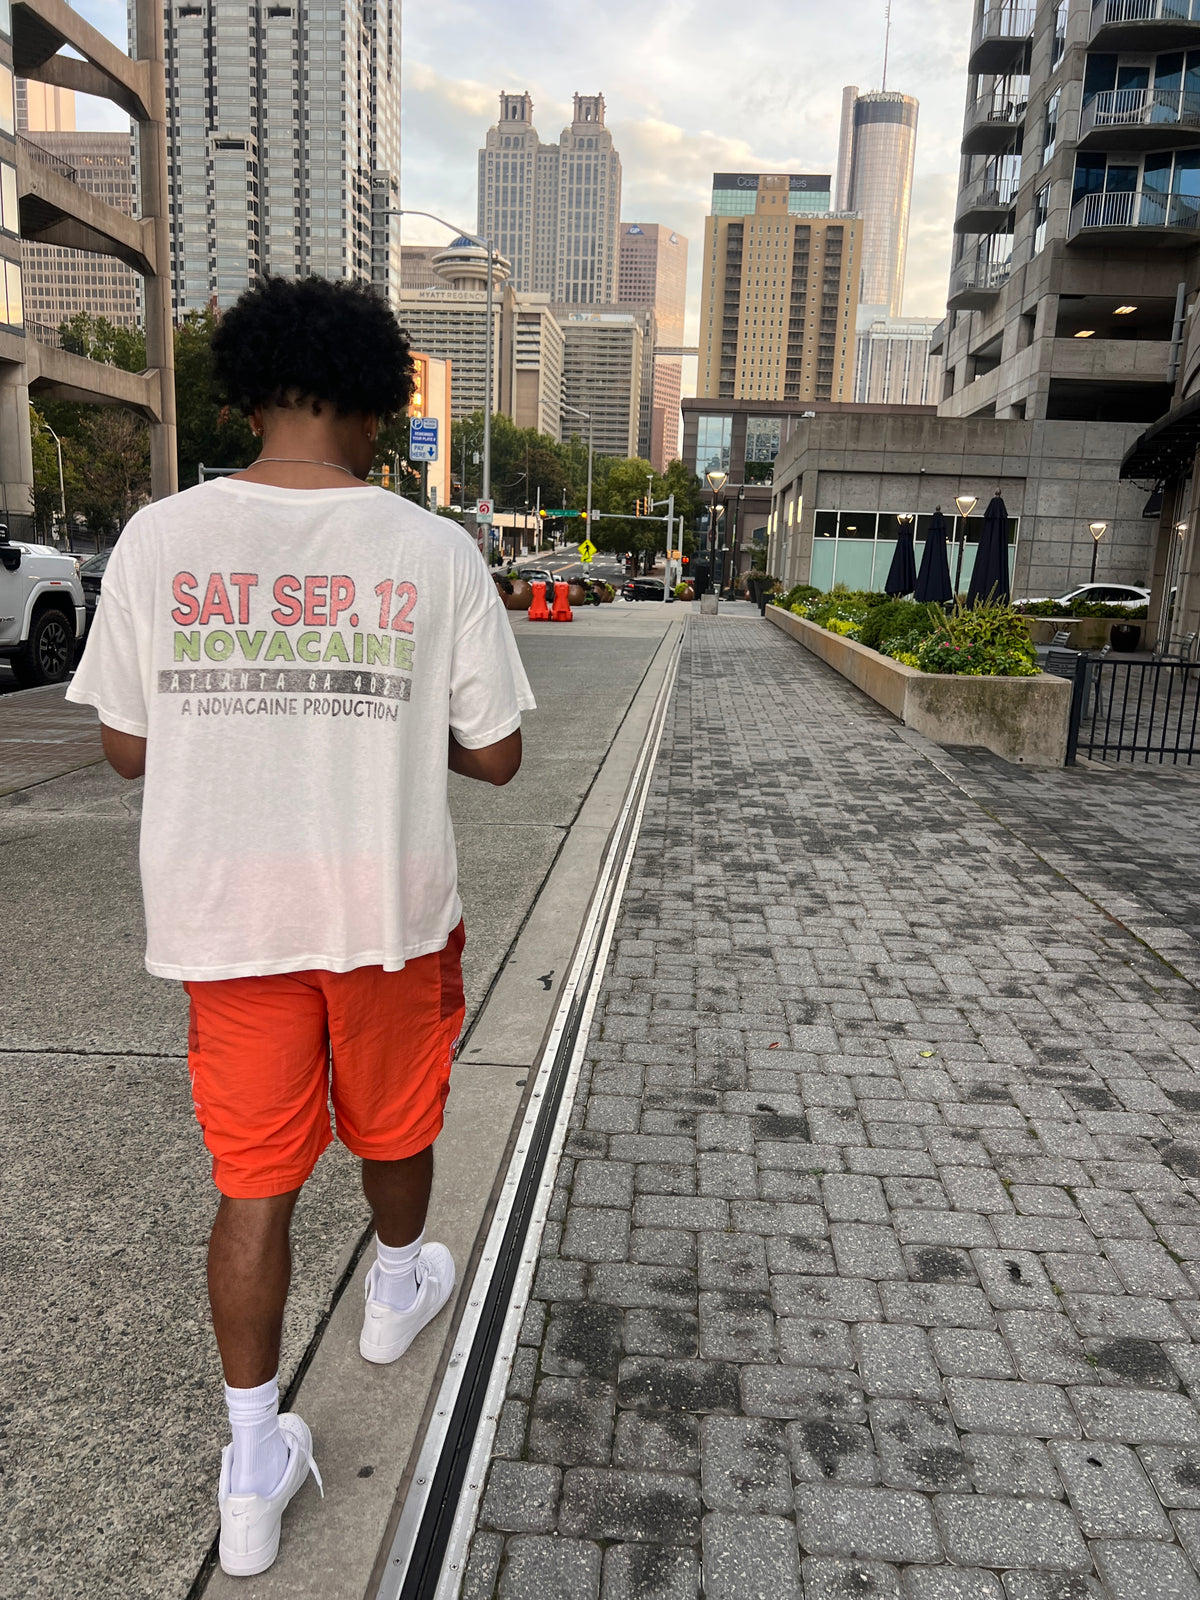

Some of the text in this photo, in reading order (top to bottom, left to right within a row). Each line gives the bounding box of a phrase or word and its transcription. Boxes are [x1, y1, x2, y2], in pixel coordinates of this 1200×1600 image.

[171, 571, 418, 635] SAT SEP. 12
[173, 630, 416, 672] NOVACAINE
[170, 672, 286, 692] ATLANTA
[308, 673, 331, 691] GA
[181, 697, 399, 722] A NOVACAINE PRODUCTION
